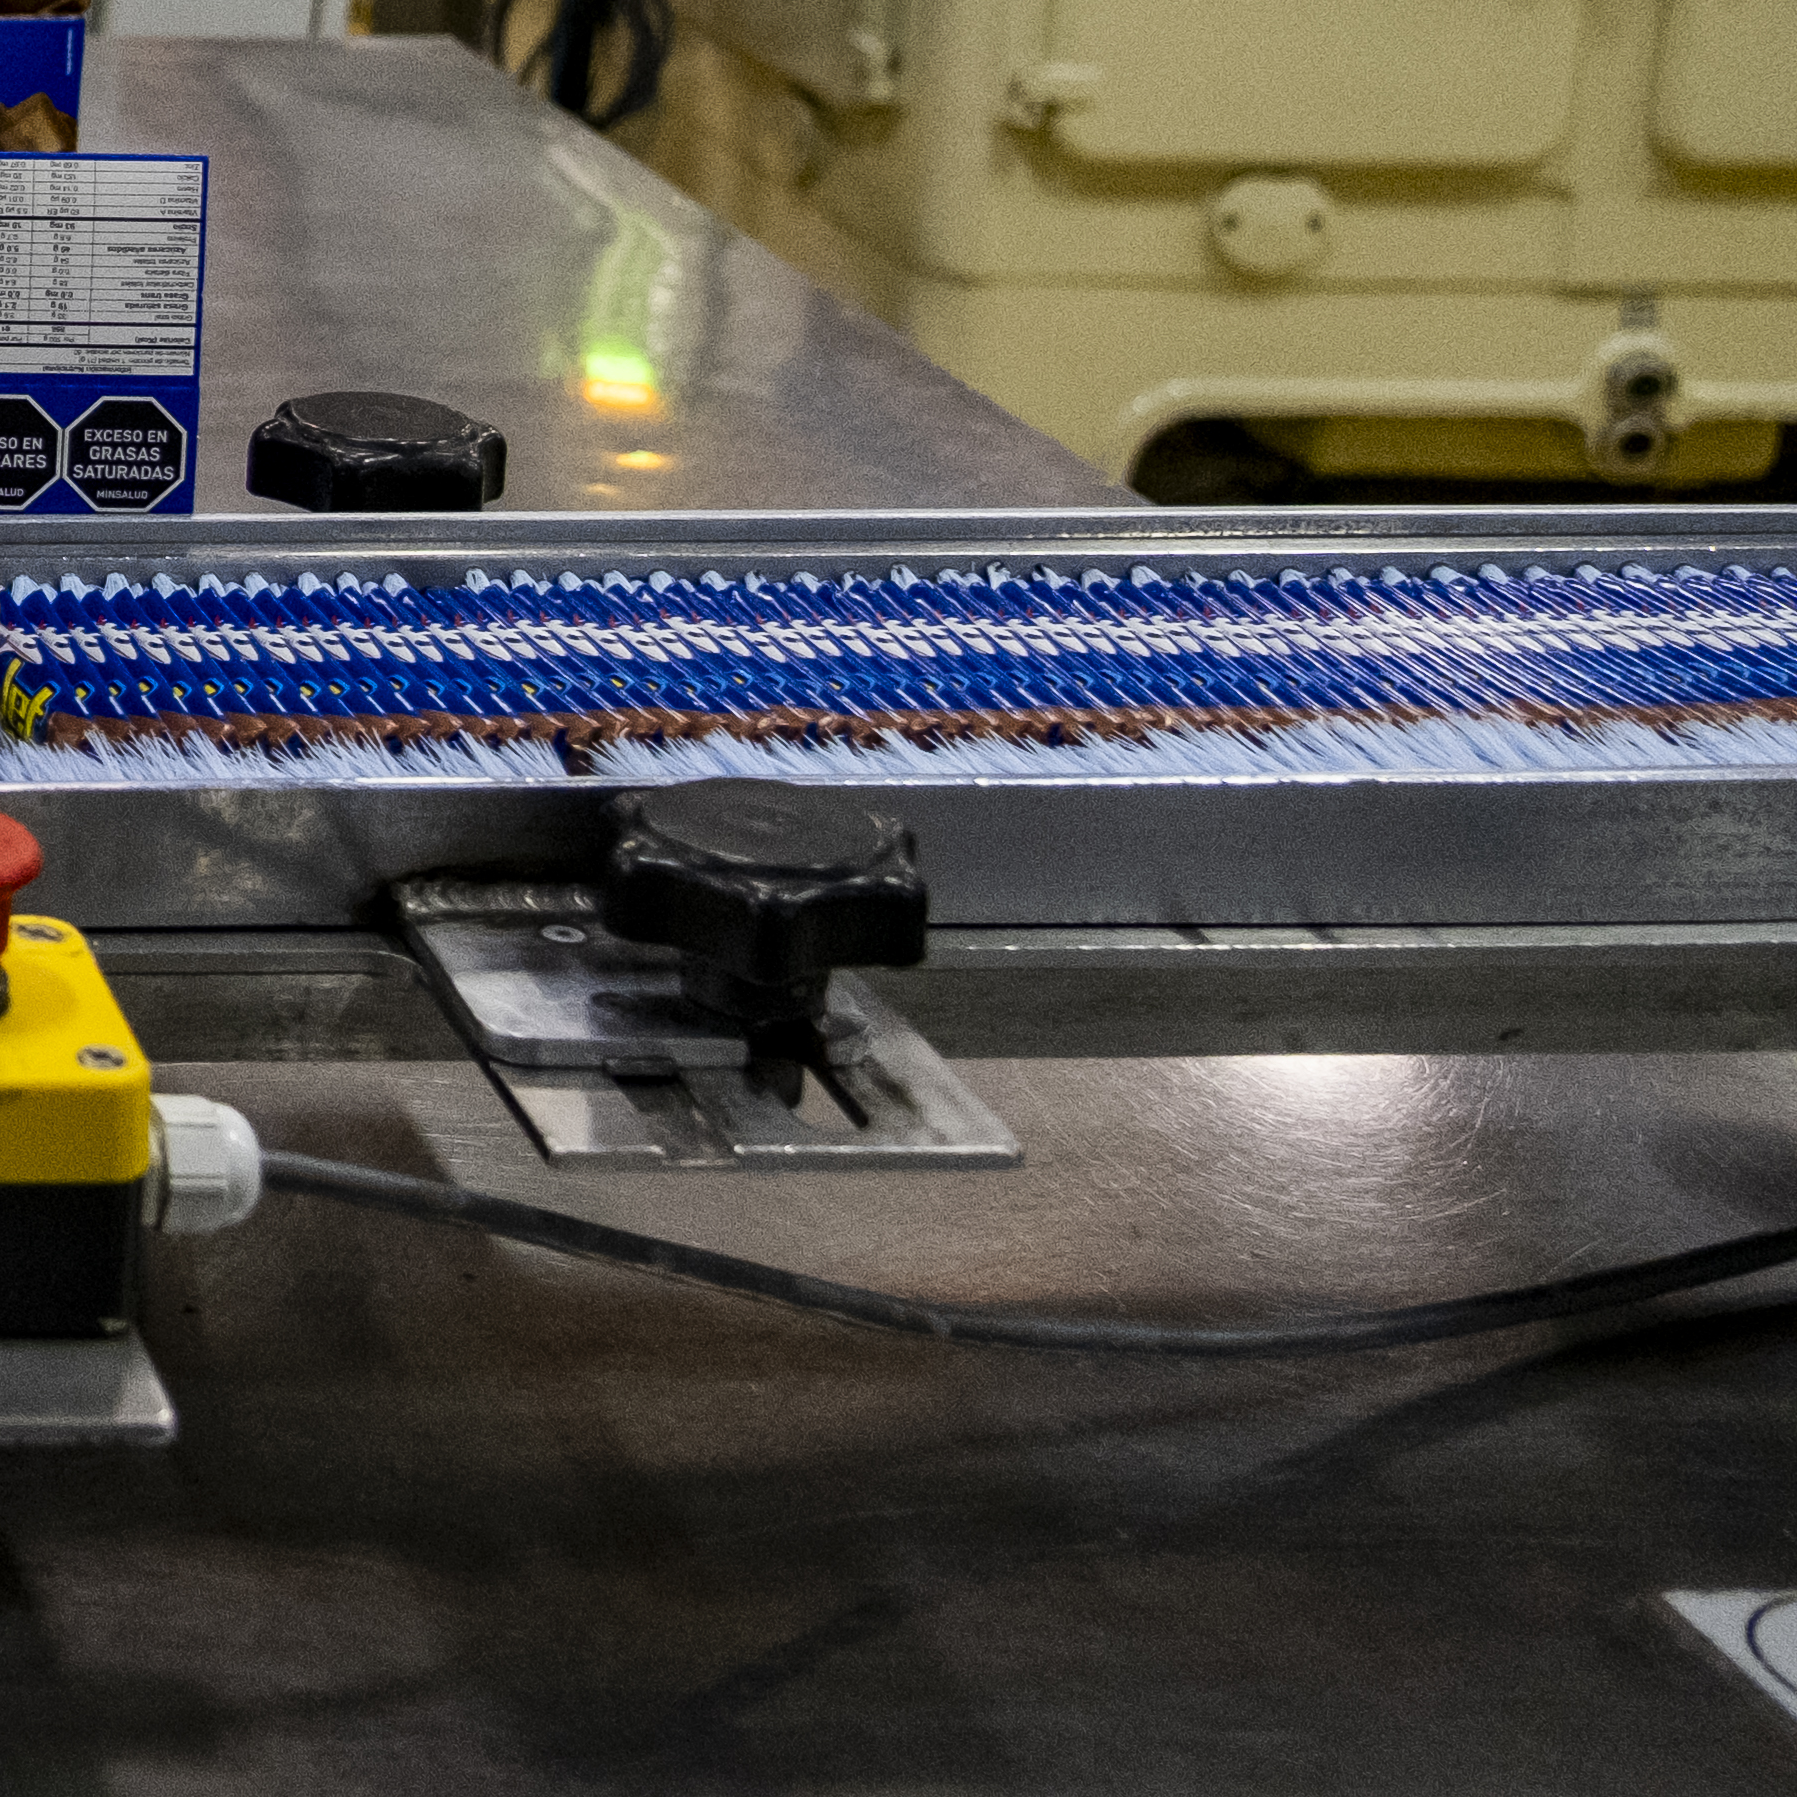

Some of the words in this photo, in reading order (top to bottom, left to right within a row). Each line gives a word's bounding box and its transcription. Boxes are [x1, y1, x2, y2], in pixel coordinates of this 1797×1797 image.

[84, 428, 143, 443] EXCESO
[147, 430, 168, 443] EN
[23, 437, 43, 450] EN
[89, 446, 161, 462] GRASAS
[73, 465, 175, 481] SATURADAS
[96, 489, 149, 500] MINSALUD
